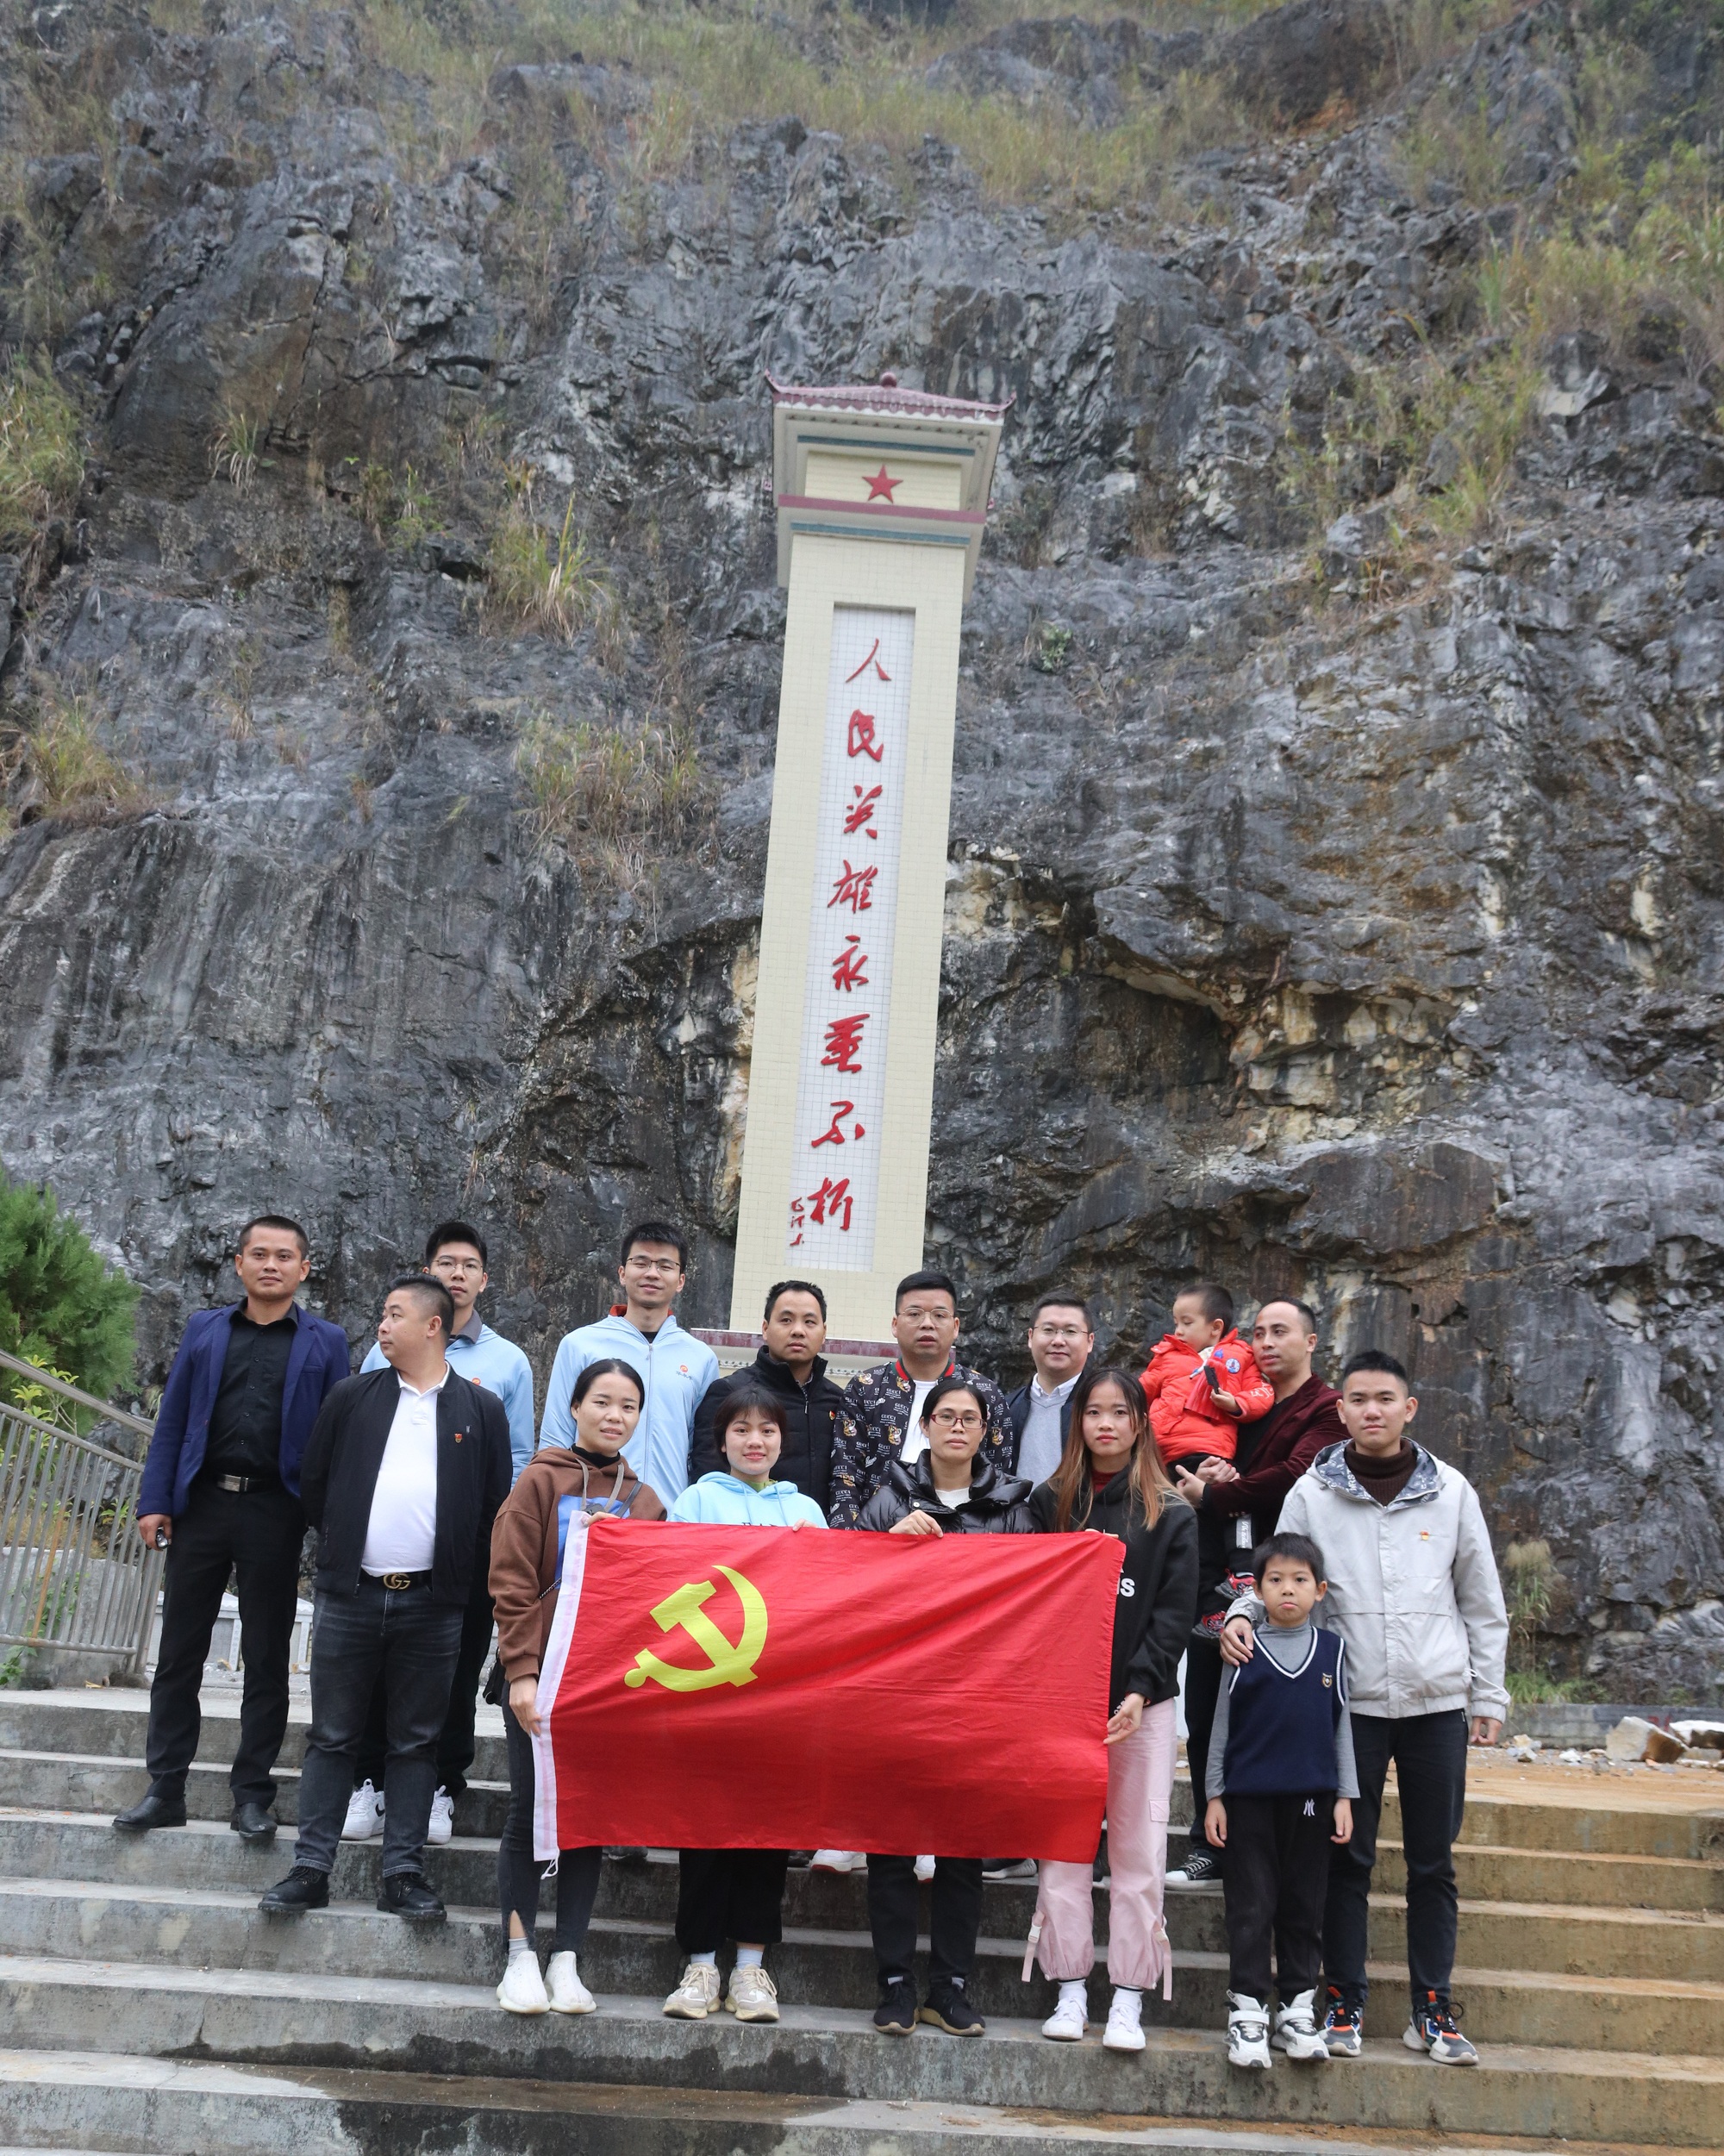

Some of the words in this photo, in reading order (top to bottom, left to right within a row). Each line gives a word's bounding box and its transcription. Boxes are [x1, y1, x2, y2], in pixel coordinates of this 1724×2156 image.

[808, 638, 891, 1232] 人民英雄永垂不朽
